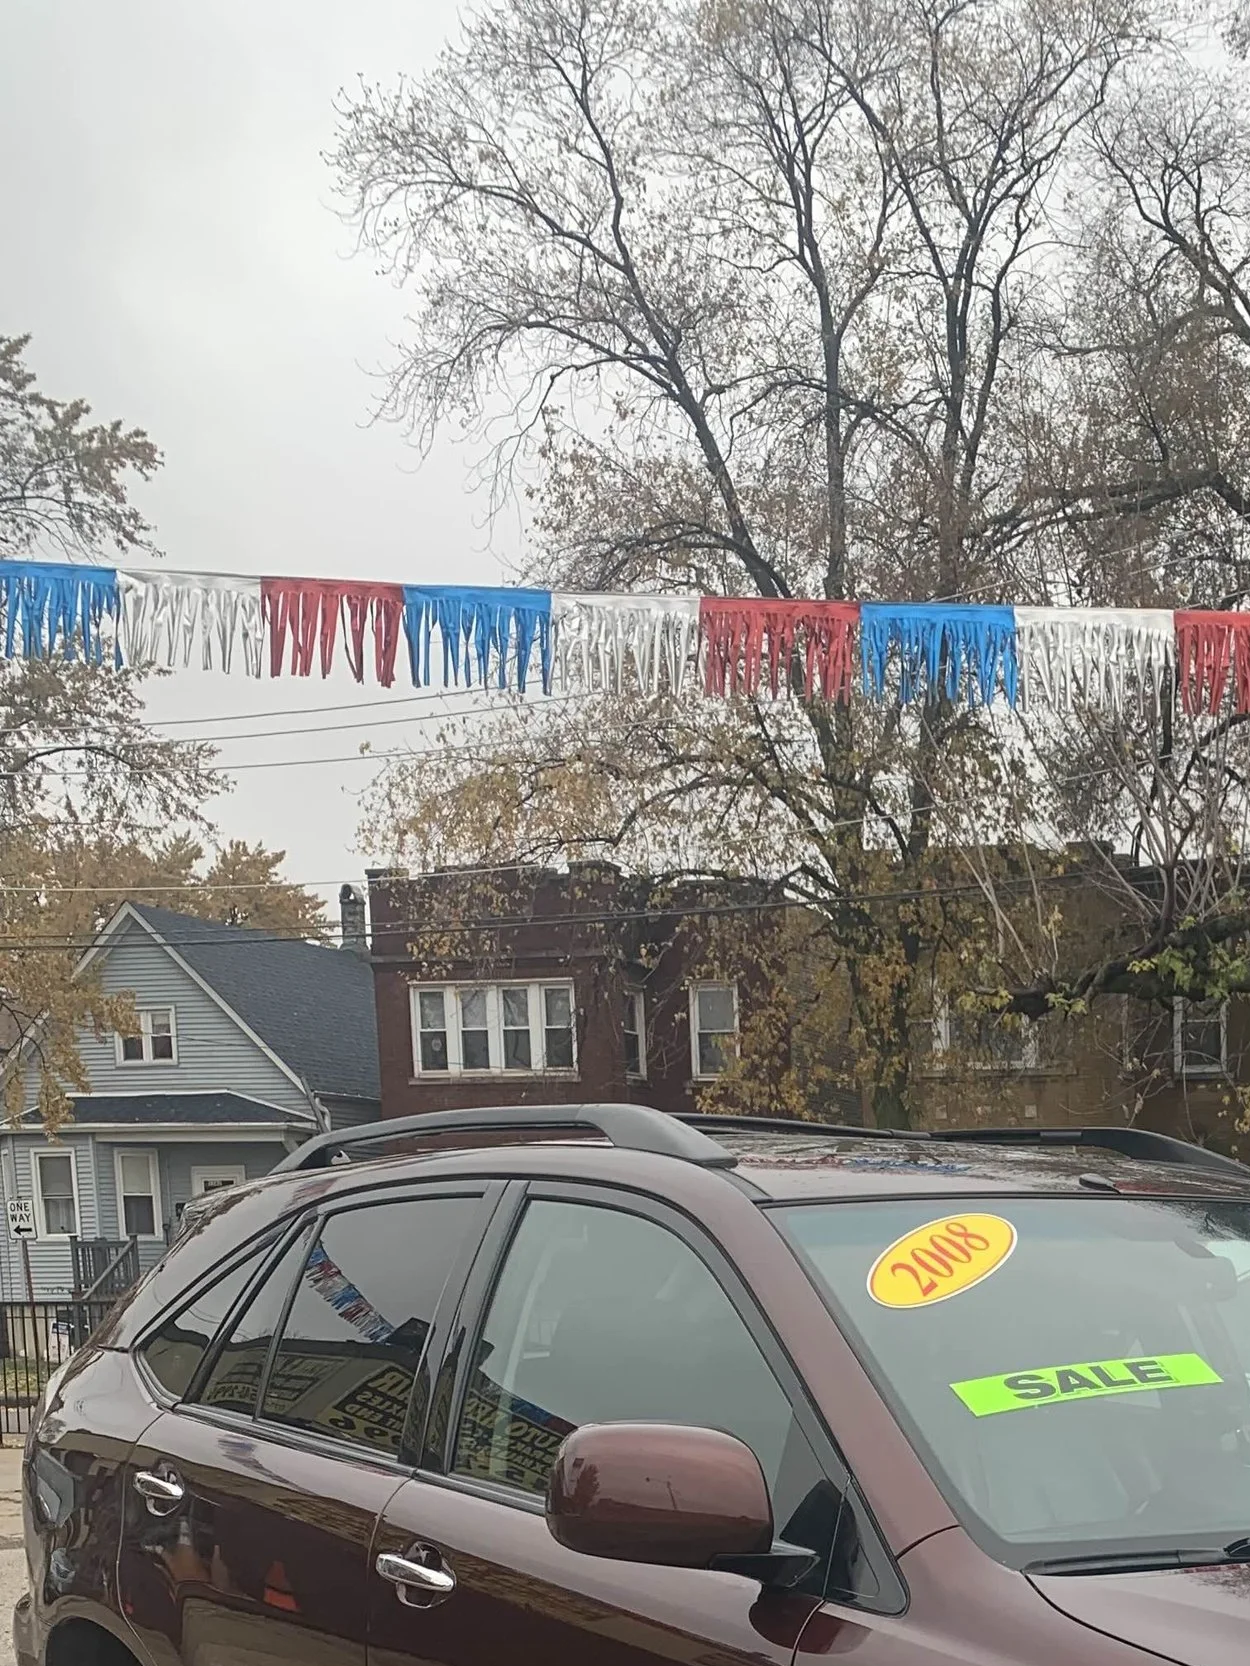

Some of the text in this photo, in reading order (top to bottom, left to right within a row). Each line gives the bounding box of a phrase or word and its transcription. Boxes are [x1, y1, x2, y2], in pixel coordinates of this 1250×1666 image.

[9, 1202, 30, 1212] ONE
[9, 1212, 32, 1223] WAY
[891, 1222, 990, 1297] 2008
[1003, 1359, 1173, 1400] SALE
